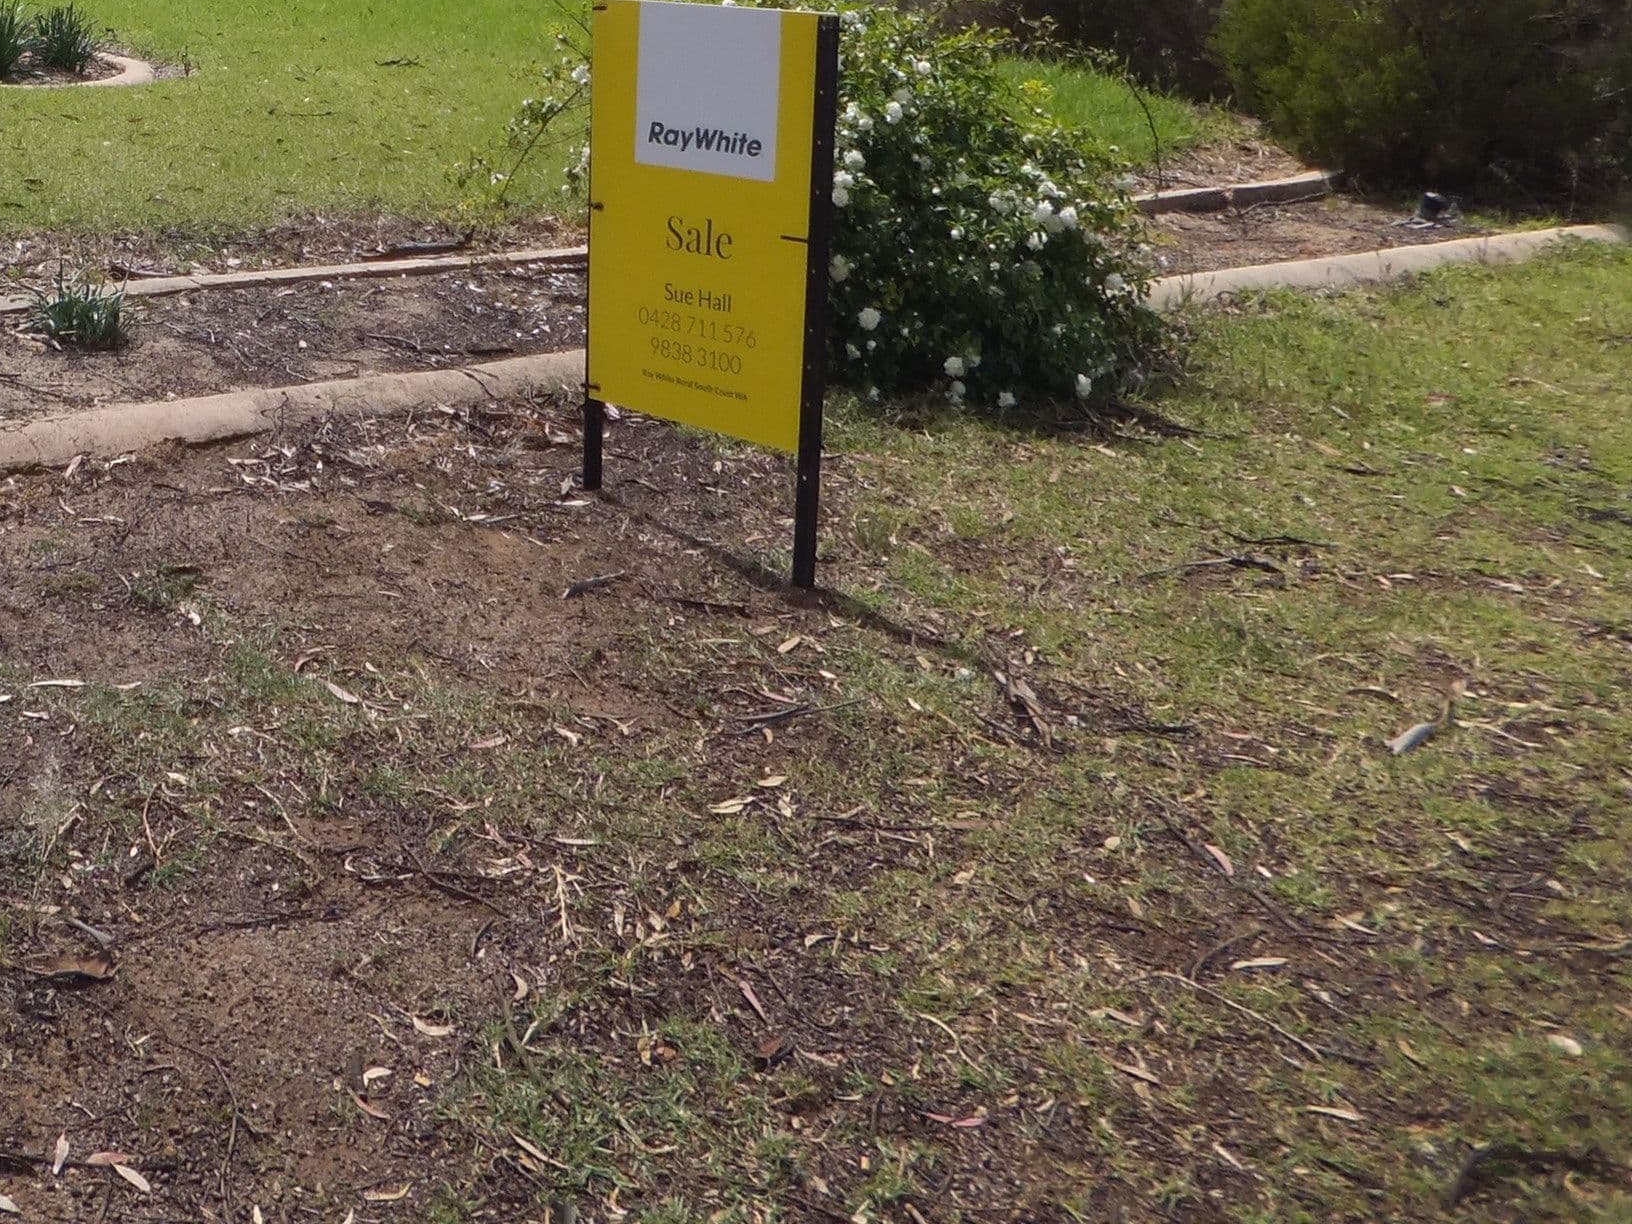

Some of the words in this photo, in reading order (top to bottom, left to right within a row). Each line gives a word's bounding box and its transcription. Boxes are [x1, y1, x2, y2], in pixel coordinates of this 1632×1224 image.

[648, 122, 762, 157] RayWhite
[666, 215, 733, 260] Sale
[664, 283, 694, 306] Sue
[699, 289, 732, 313] Hall
[638, 307, 681, 332] 0428
[687, 316, 717, 341] 711
[723, 324, 757, 349] 576
[650, 337, 693, 364] 9838
[697, 348, 742, 375] 3100
